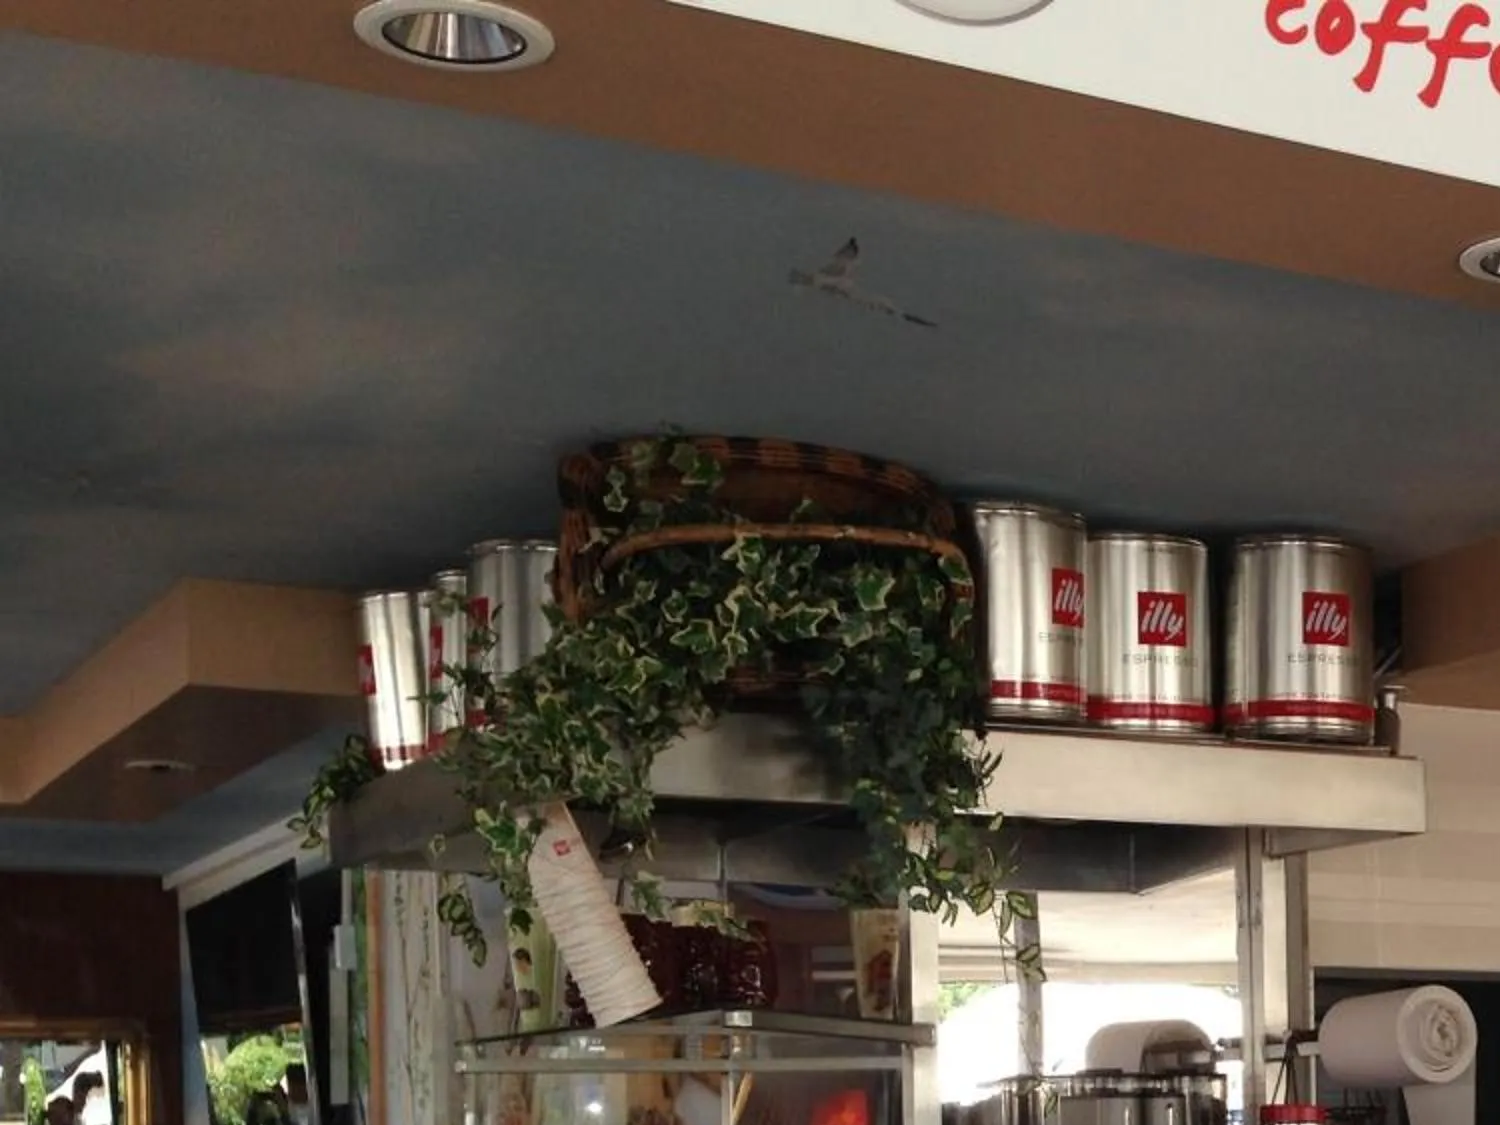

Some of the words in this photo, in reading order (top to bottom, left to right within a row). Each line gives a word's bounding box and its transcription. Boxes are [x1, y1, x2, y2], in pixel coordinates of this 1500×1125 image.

[1054, 579, 1084, 621] illy
[1141, 600, 1184, 641] illy
[1305, 600, 1347, 640] illy
